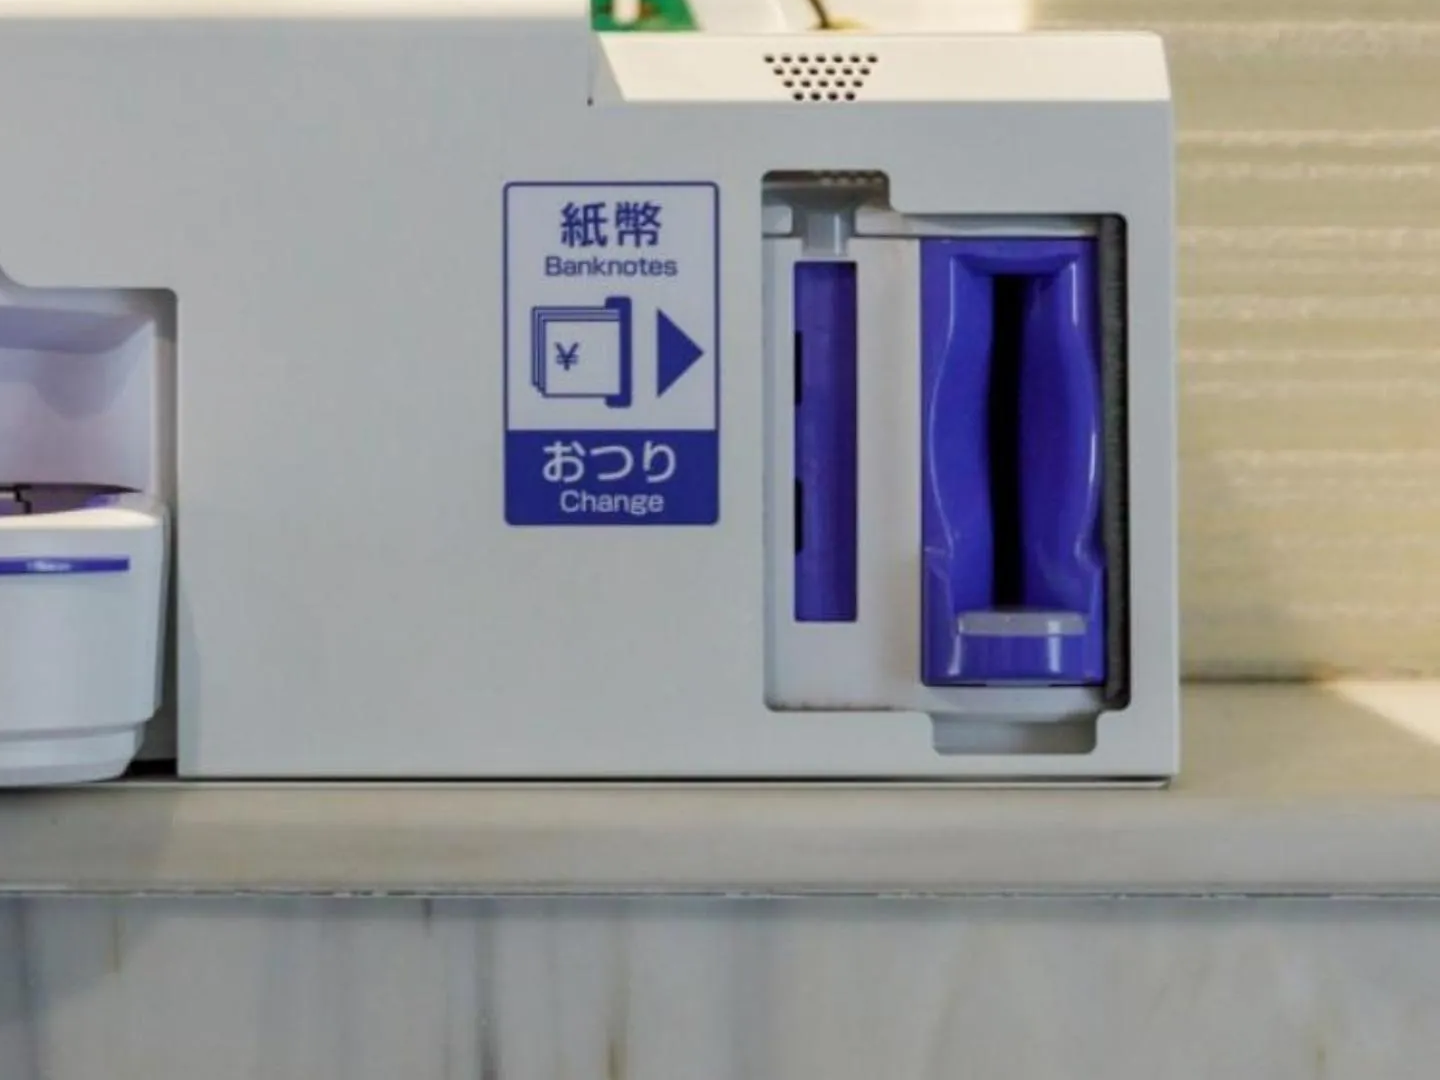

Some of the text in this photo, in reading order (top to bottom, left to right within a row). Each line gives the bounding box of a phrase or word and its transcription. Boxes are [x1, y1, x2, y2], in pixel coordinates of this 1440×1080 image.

[559, 199, 663, 250] 紙幣
[543, 254, 679, 279] Banknotes
[541, 440, 677, 484] おつり
[558, 489, 666, 517] Change
